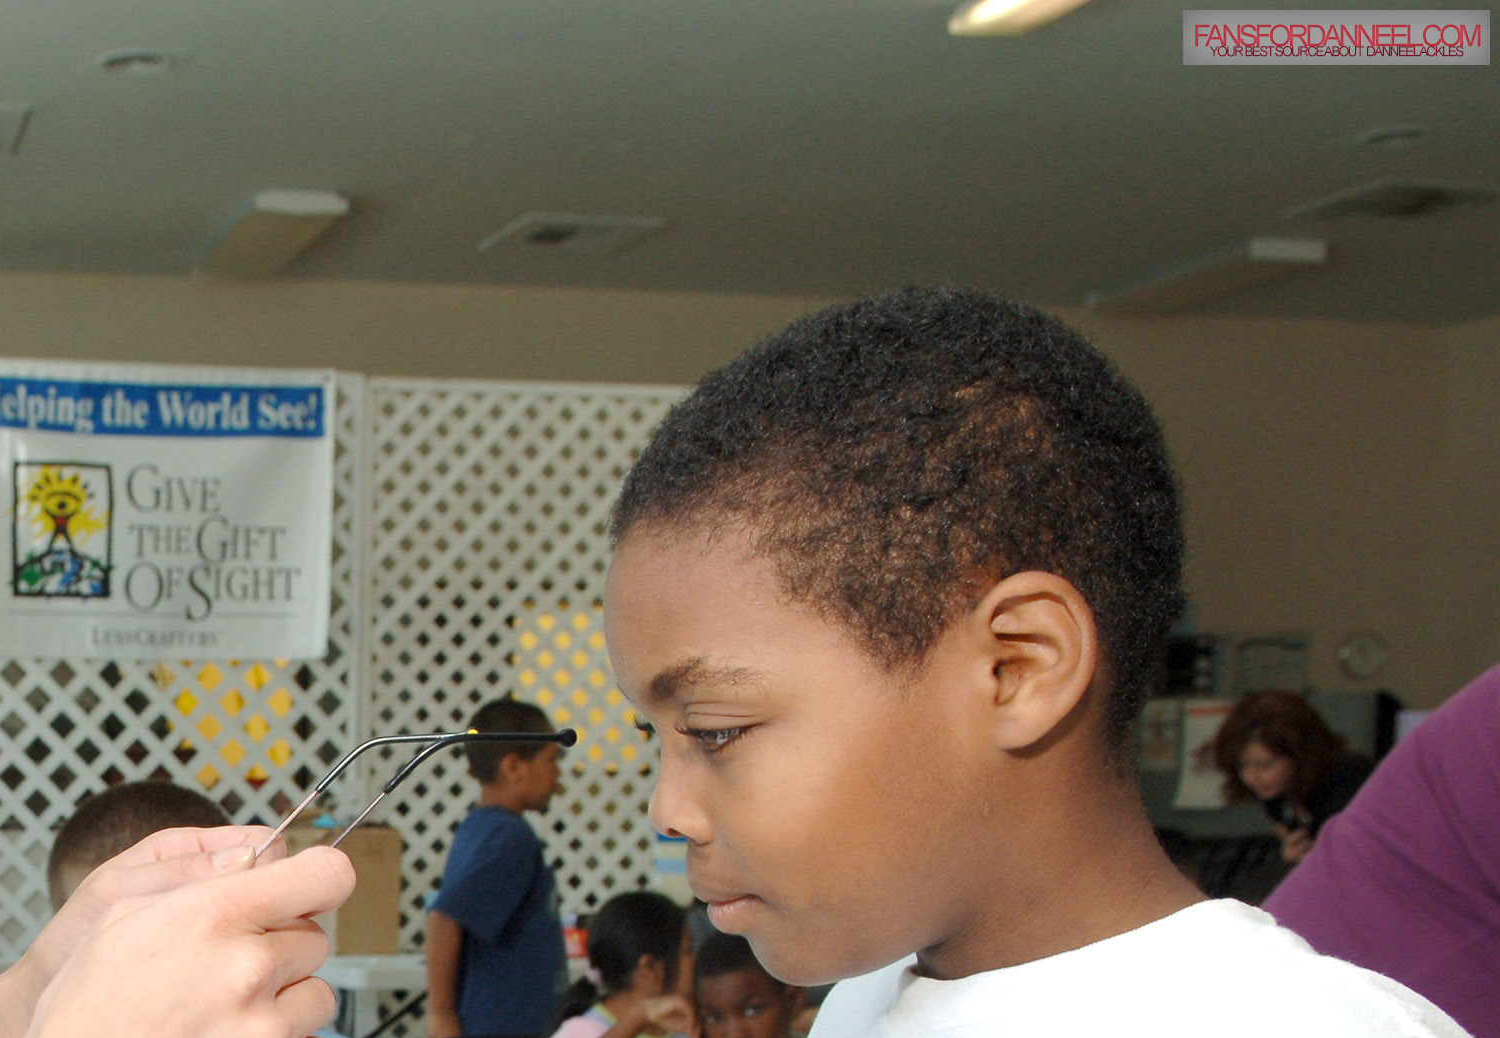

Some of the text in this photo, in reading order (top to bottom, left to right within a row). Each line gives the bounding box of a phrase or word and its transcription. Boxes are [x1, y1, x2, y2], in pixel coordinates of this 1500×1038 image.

[102, 388, 149, 428] the
[156, 390, 249, 430] World
[257, 392, 317, 430] See!
[129, 513, 286, 564] THE GIFT
